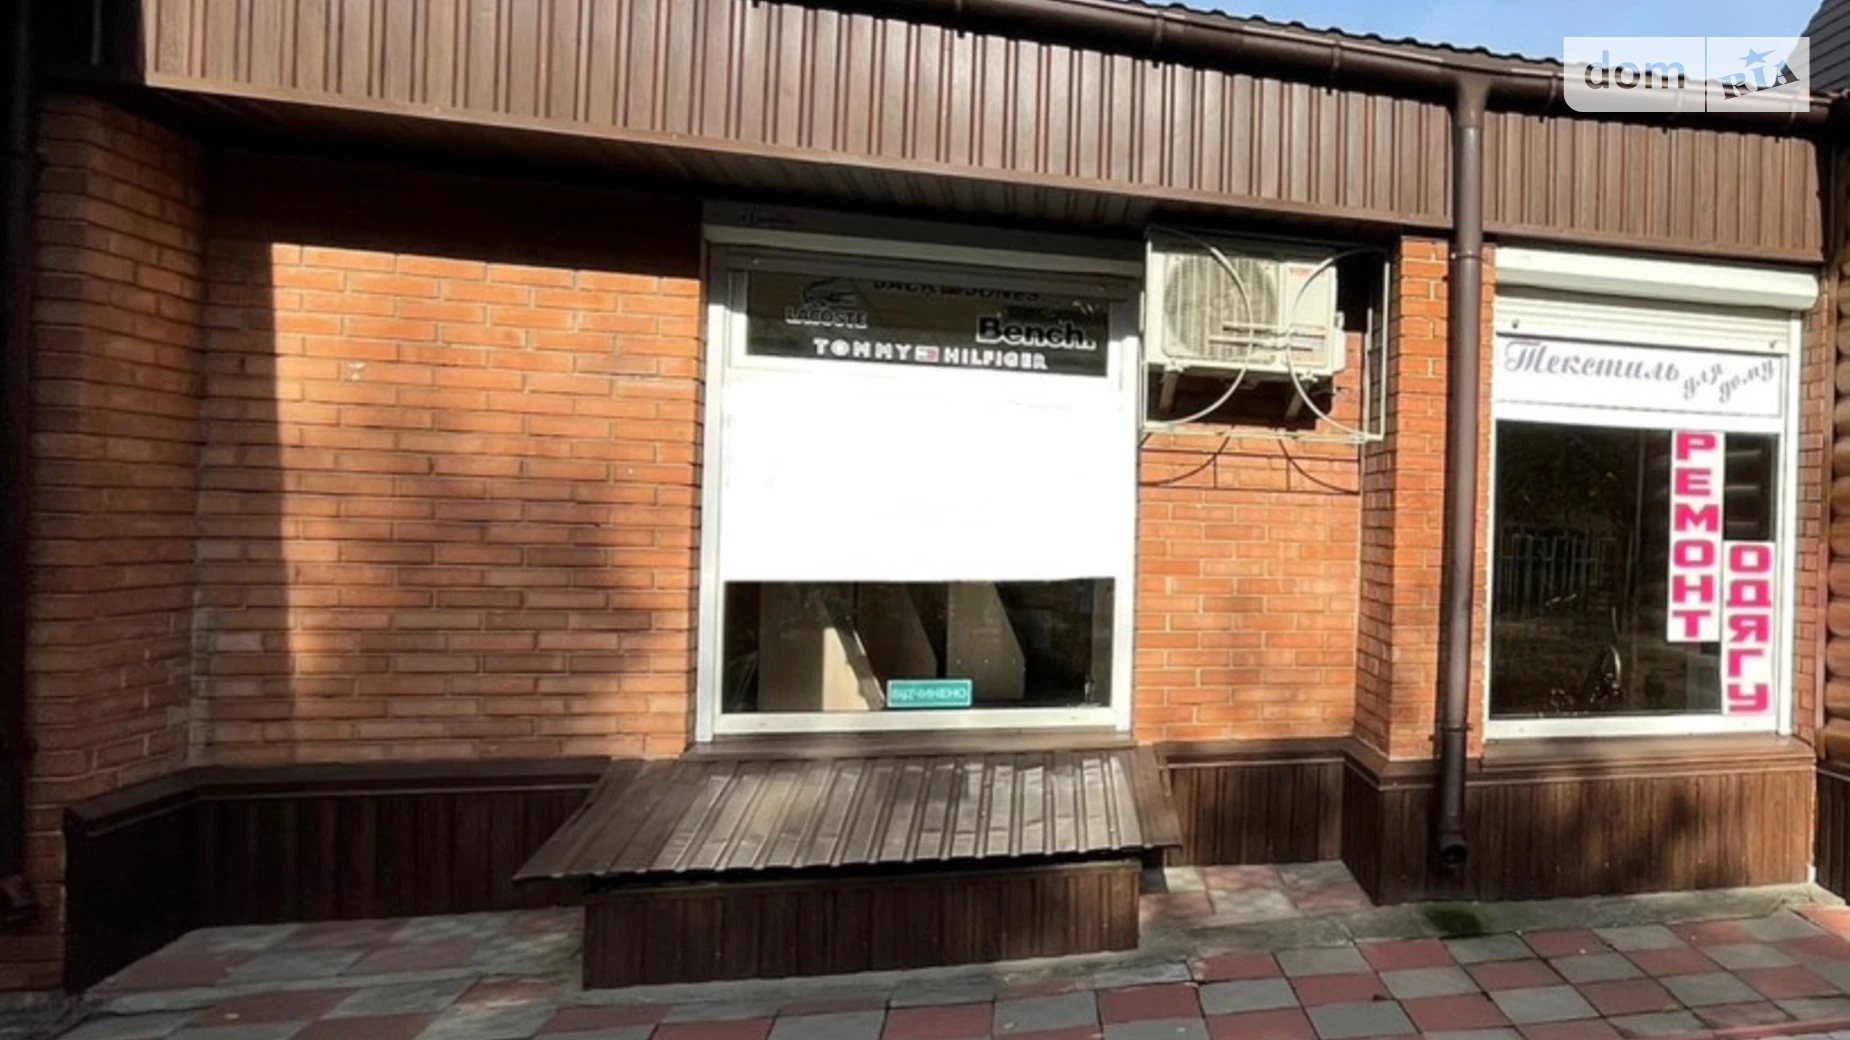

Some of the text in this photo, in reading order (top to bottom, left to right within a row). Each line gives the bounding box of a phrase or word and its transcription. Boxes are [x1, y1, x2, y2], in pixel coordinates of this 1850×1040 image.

[785, 305, 869, 330] LACOSTE
[976, 314, 1097, 350] Bench.
[813, 338, 1048, 370] TOMMY HILFIGER
[1504, 340, 1775, 404] Текстиль для дому
[1672, 432, 1720, 638] РЕМОНТ
[1726, 544, 1772, 713] ОДЯГУ
